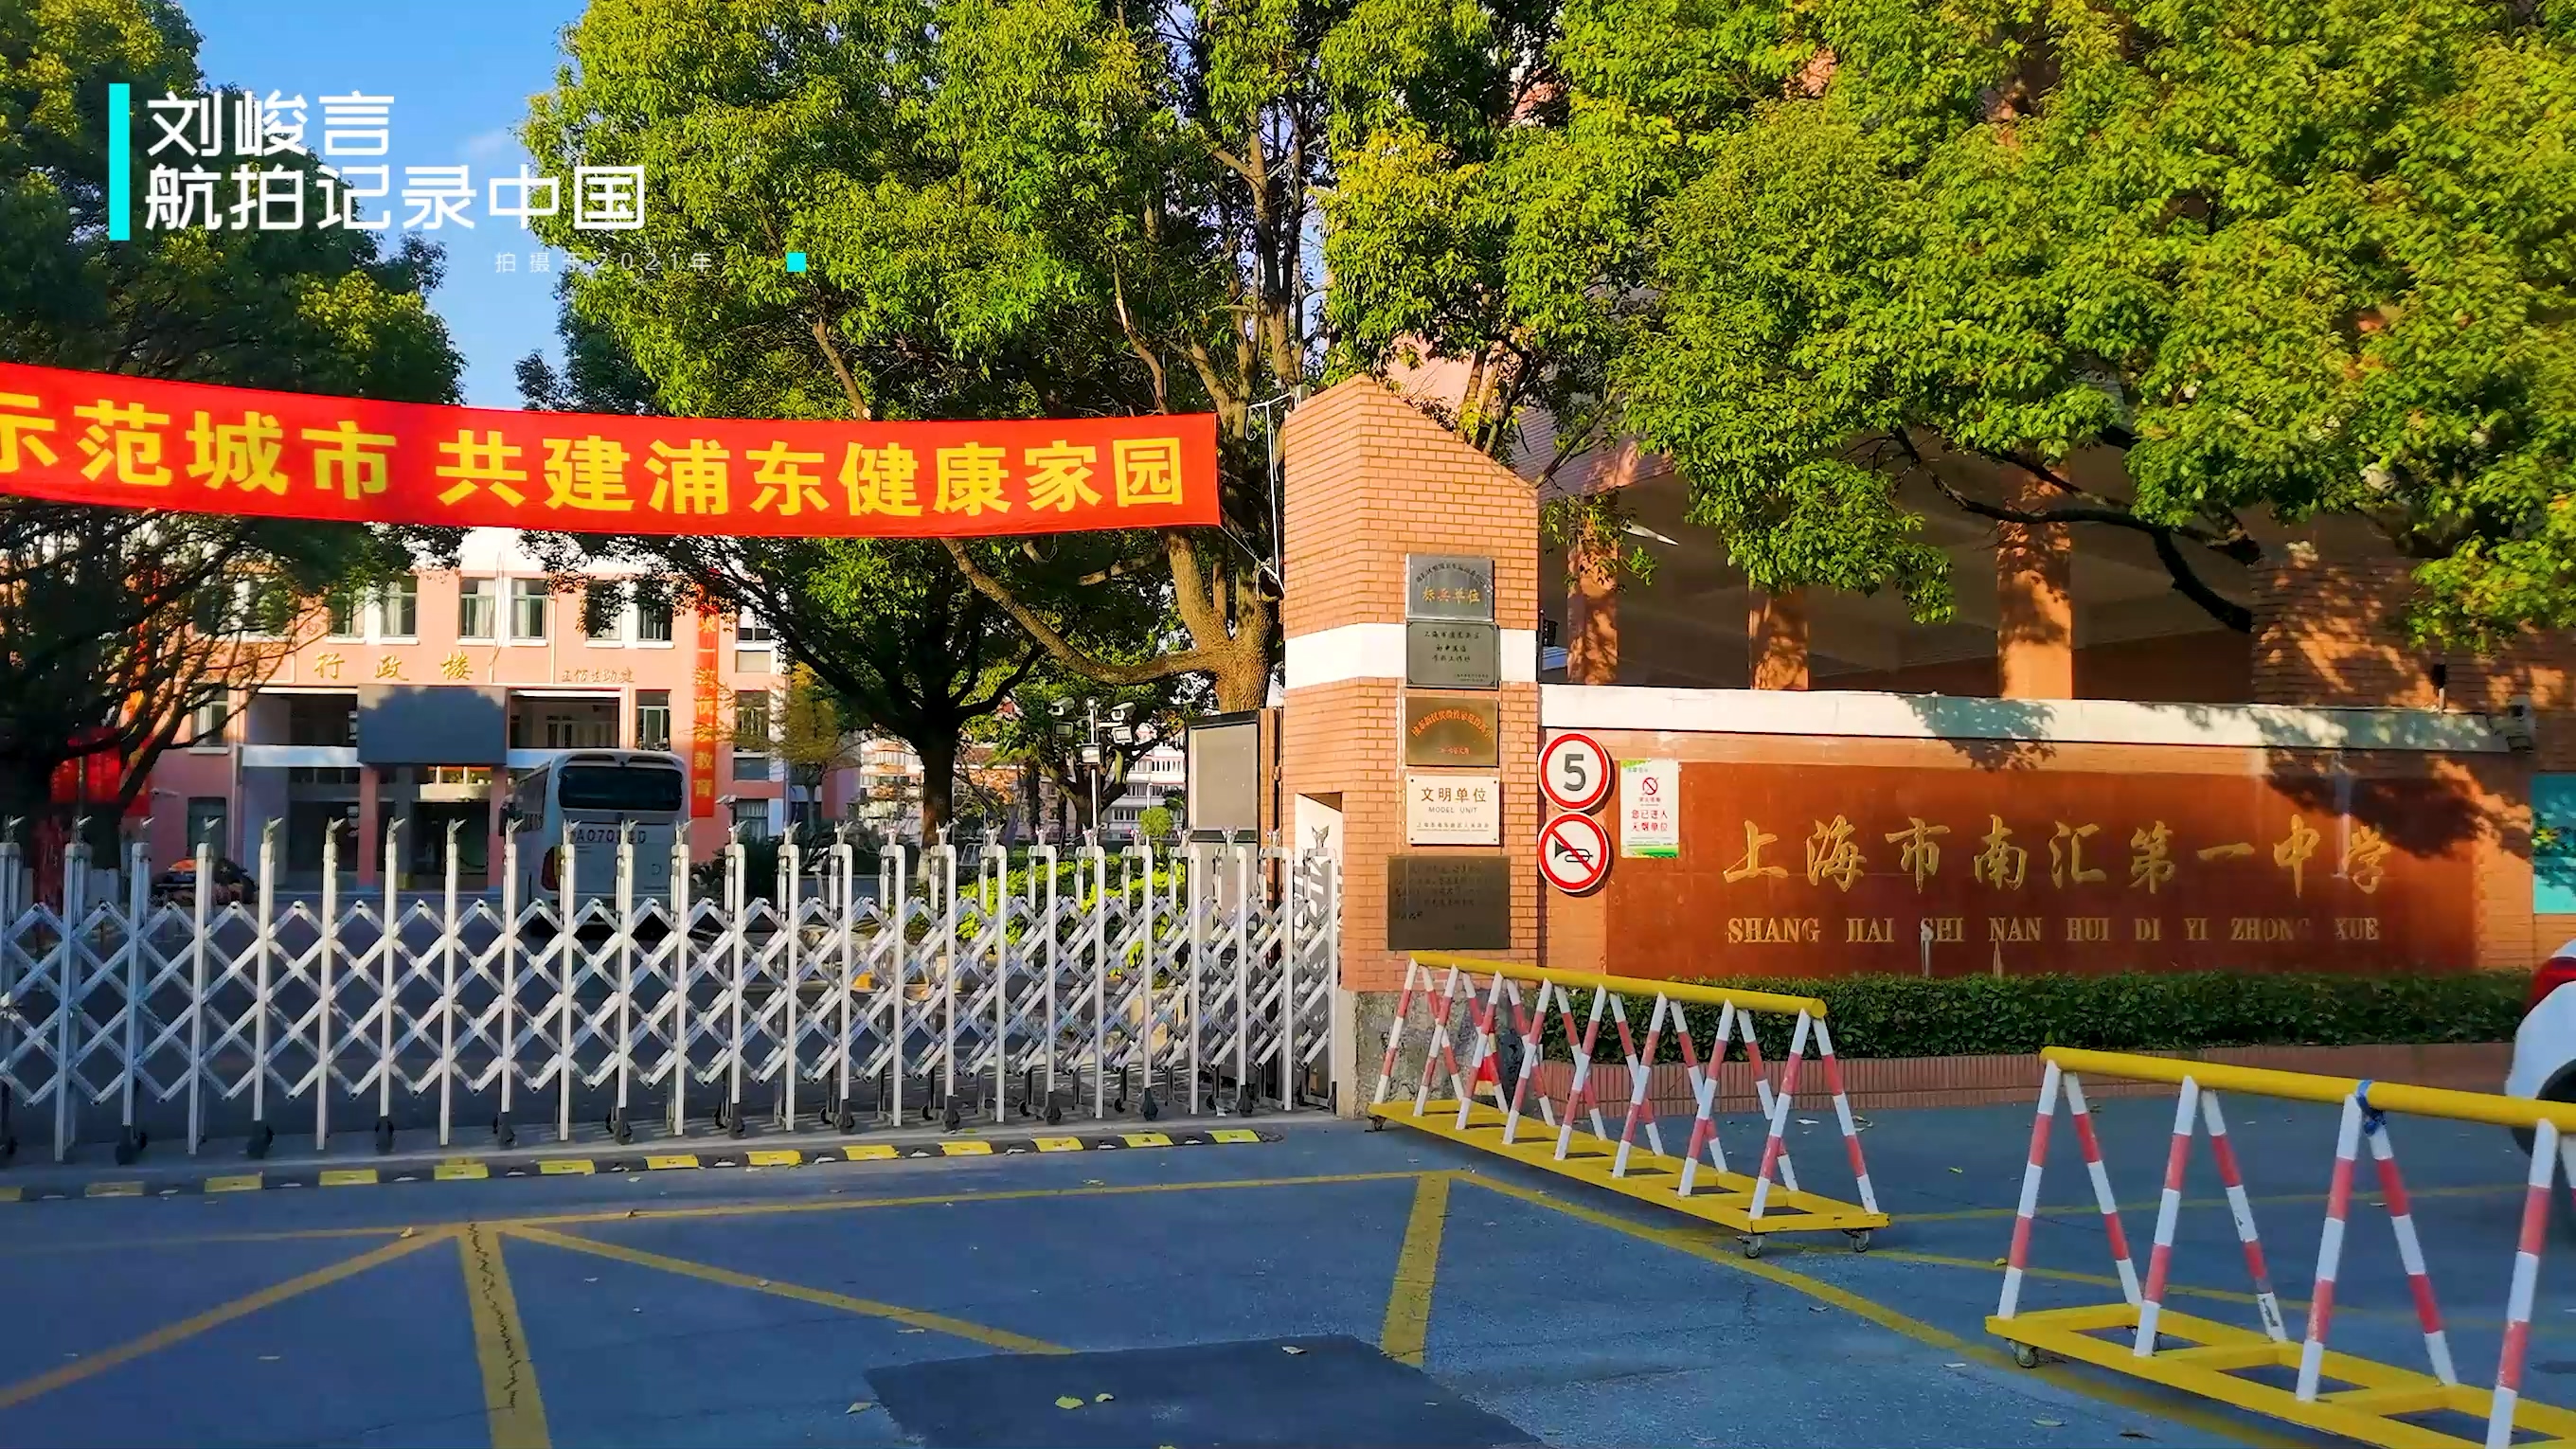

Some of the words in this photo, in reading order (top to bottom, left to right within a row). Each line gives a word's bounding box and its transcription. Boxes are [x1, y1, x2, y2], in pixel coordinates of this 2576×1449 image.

[0, 392, 395, 501] 示范城市
[436, 428, 1184, 519] 共建浦东健康家园
[313, 651, 474, 682] 行政楼
[1563, 754, 1586, 791] 5
[1421, 786, 1487, 803] 文明单位
[1459, 806, 1477, 814] UNIT
[1723, 814, 2391, 899] 上海市南汇第一中学
[1726, 916, 1821, 944] SHANG
[1846, 917, 1895, 943] HAI
[1919, 916, 1964, 942] SHI
[1988, 917, 2043, 941] NAN
[2065, 917, 2111, 941] HUI
[2134, 918, 2162, 941] DI
[2184, 918, 2209, 941] YI
[2334, 917, 2380, 940] XUE
